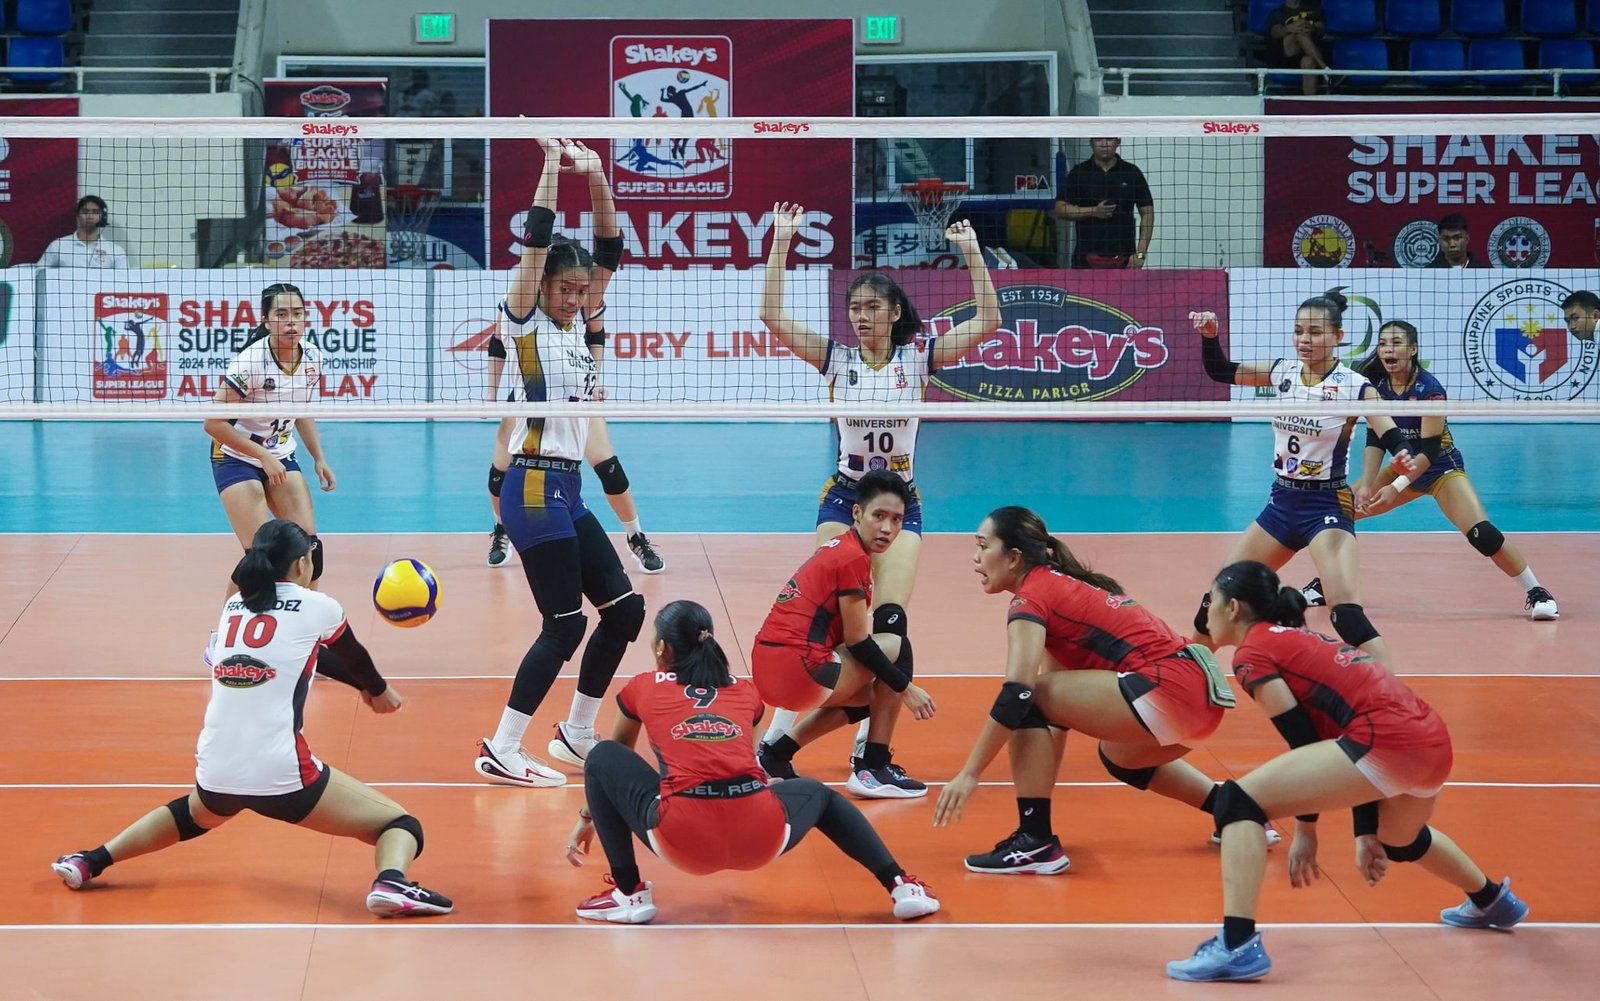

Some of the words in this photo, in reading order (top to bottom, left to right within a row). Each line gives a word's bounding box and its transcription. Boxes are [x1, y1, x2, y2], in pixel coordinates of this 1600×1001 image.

[420, 15, 451, 38] EXIT
[866, 16, 896, 40] EXIT
[625, 44, 718, 66] Shakey's
[302, 93, 348, 104] Shakey's
[302, 123, 358, 136] Shakey's
[753, 121, 810, 134] Shakey's
[1203, 121, 1260, 135] Shakey's
[298, 148, 358, 159] LEAGUE
[1347, 135, 1600, 166] SHAKE
[296, 160, 359, 170] BUNDLE
[617, 182, 665, 193] SUPER
[668, 182, 726, 193] LEAGUE
[1015, 175, 1050, 191] PBA
[1347, 171, 1495, 204] SUPER
[1508, 172, 1600, 204] LEA
[508, 211, 834, 259] SHAKEYS
[102, 295, 160, 310] Shakey's
[1001, 291, 1025, 303] EST.
[1030, 290, 1061, 303] 1954
[178, 300, 375, 327] SHAEY'S
[1468, 300, 1496, 375] PHILIPPINE
[1496, 283, 1552, 302] SPORTS
[178, 328, 248, 353] SUPE
[303, 329, 377, 353] AGUE
[707, 331, 794, 358] LINE
[179, 358, 204, 370] 2024
[322, 358, 377, 370] PIONSHIP
[95, 380, 127, 389] SUPER
[128, 380, 165, 389] LEAGUE
[319, 375, 378, 397] LAY
[979, 382, 1025, 399] PIZZA
[1032, 382, 1091, 400] PARLOR
[846, 418, 910, 428] UNIVERSITY
[1274, 416, 1323, 429] ATIONAL
[863, 431, 894, 453] 10
[1287, 435, 1300, 454] 6
[515, 457, 568, 471] REBEL
[1320, 479, 1346, 490] REB
[228, 599, 302, 612] FERDEZ
[225, 613, 278, 649] 10
[214, 663, 277, 682] Shakey's
[683, 684, 718, 709] 9
[671, 719, 743, 740] Shakey's
